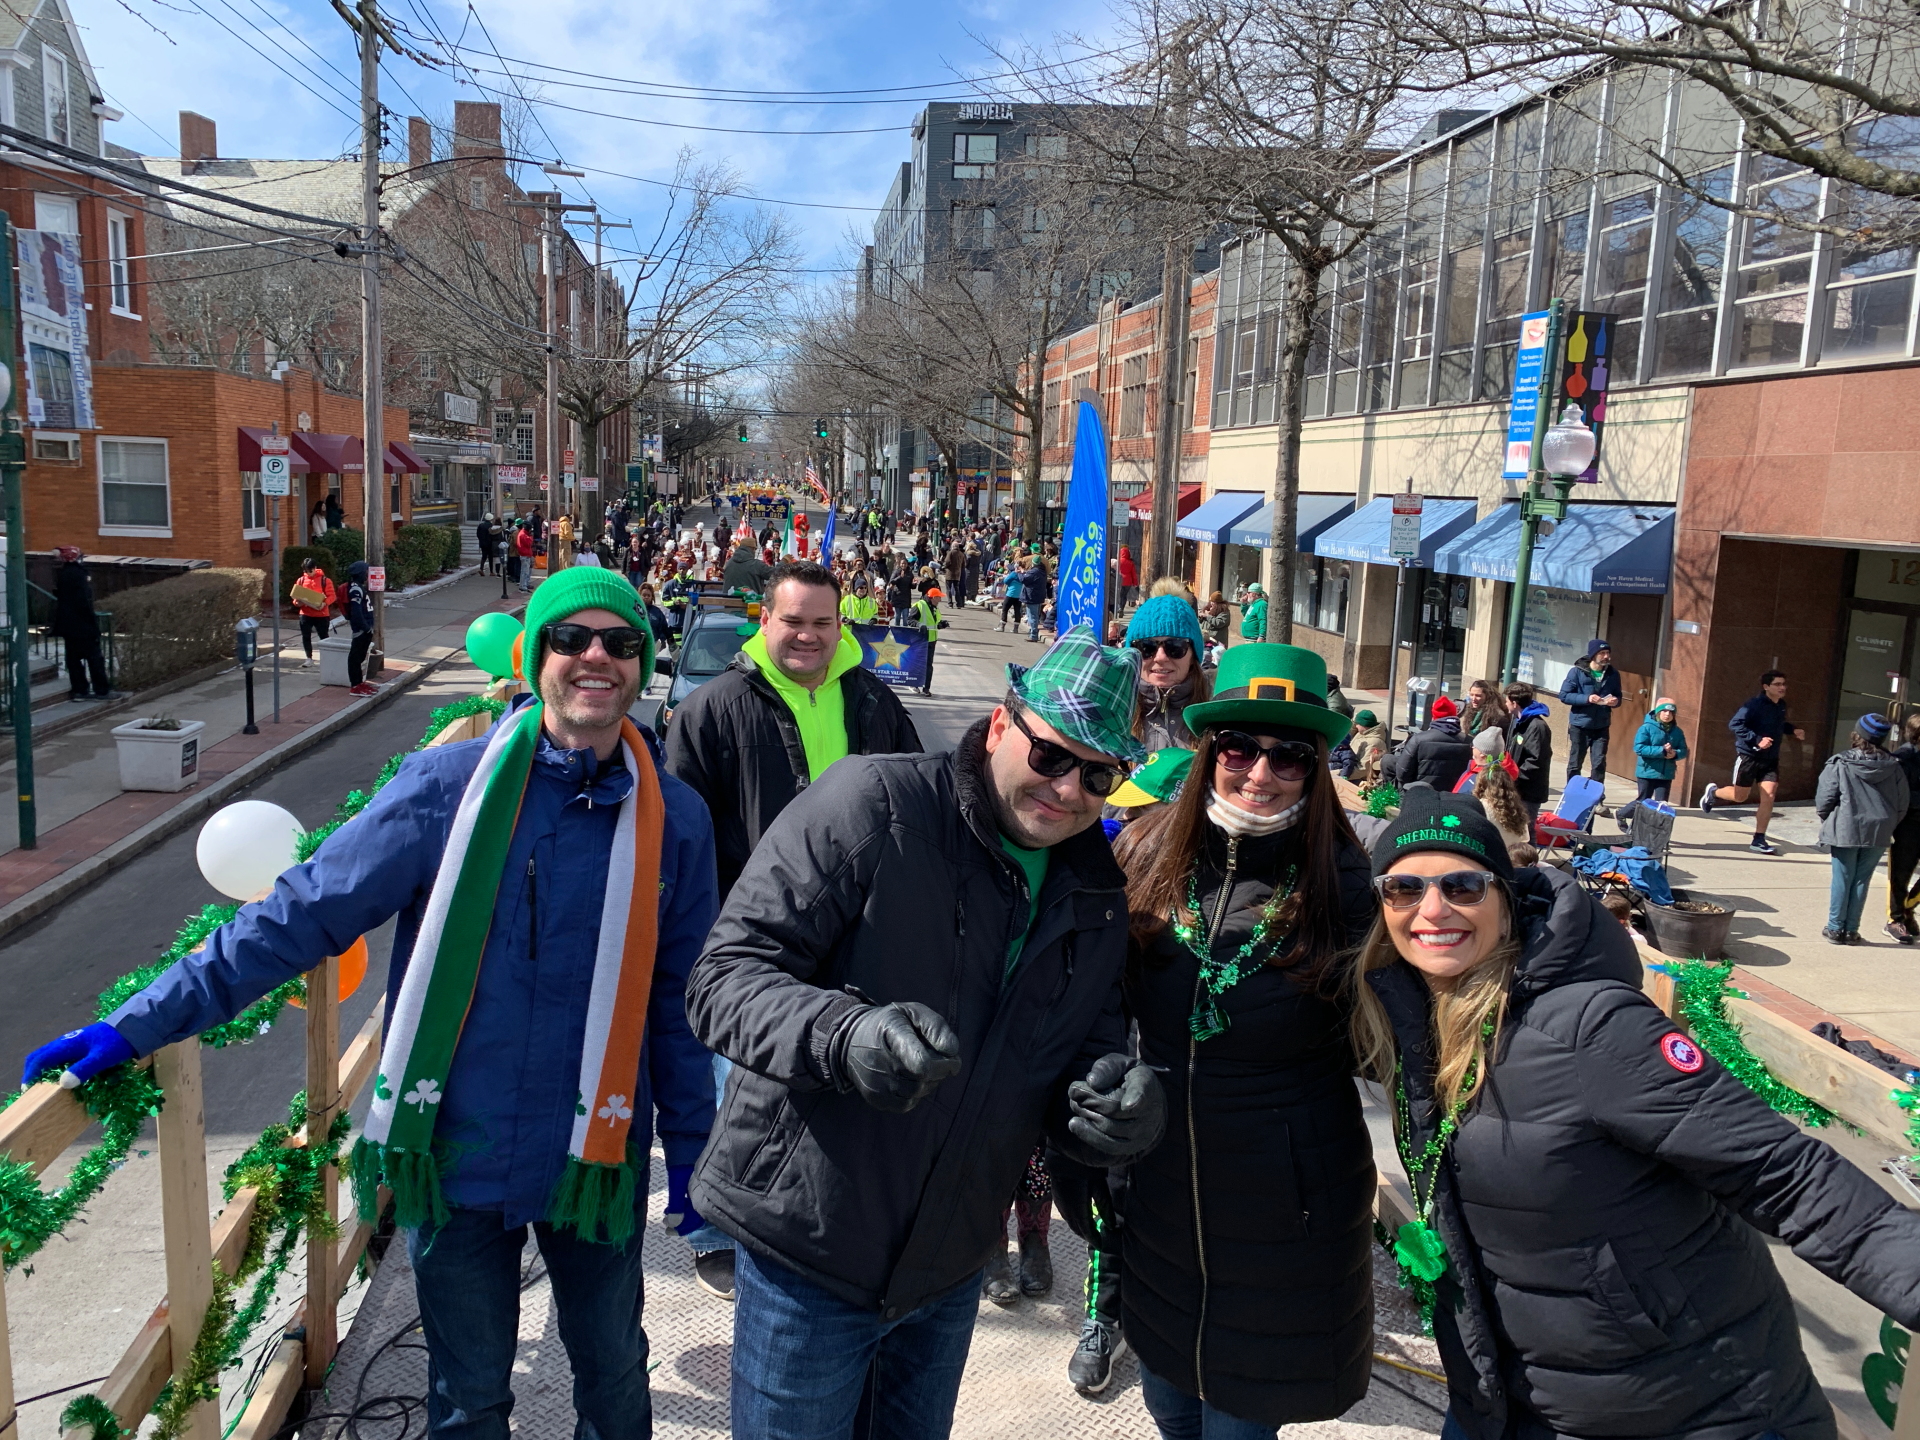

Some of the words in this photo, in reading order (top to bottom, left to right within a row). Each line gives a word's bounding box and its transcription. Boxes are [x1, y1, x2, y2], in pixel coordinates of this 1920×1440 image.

[966, 104, 1013, 119] NOVELLA
[63, 239, 88, 428] www.apartments4yale.com
[1083, 521, 1098, 586] 99.9
[1348, 545, 1370, 559] Medical
[1472, 562, 1488, 574] Walk
[1089, 566, 1101, 608] Best
[1431, 815, 1435, 825] I
[1396, 828, 1486, 856] SHENANIGANS
